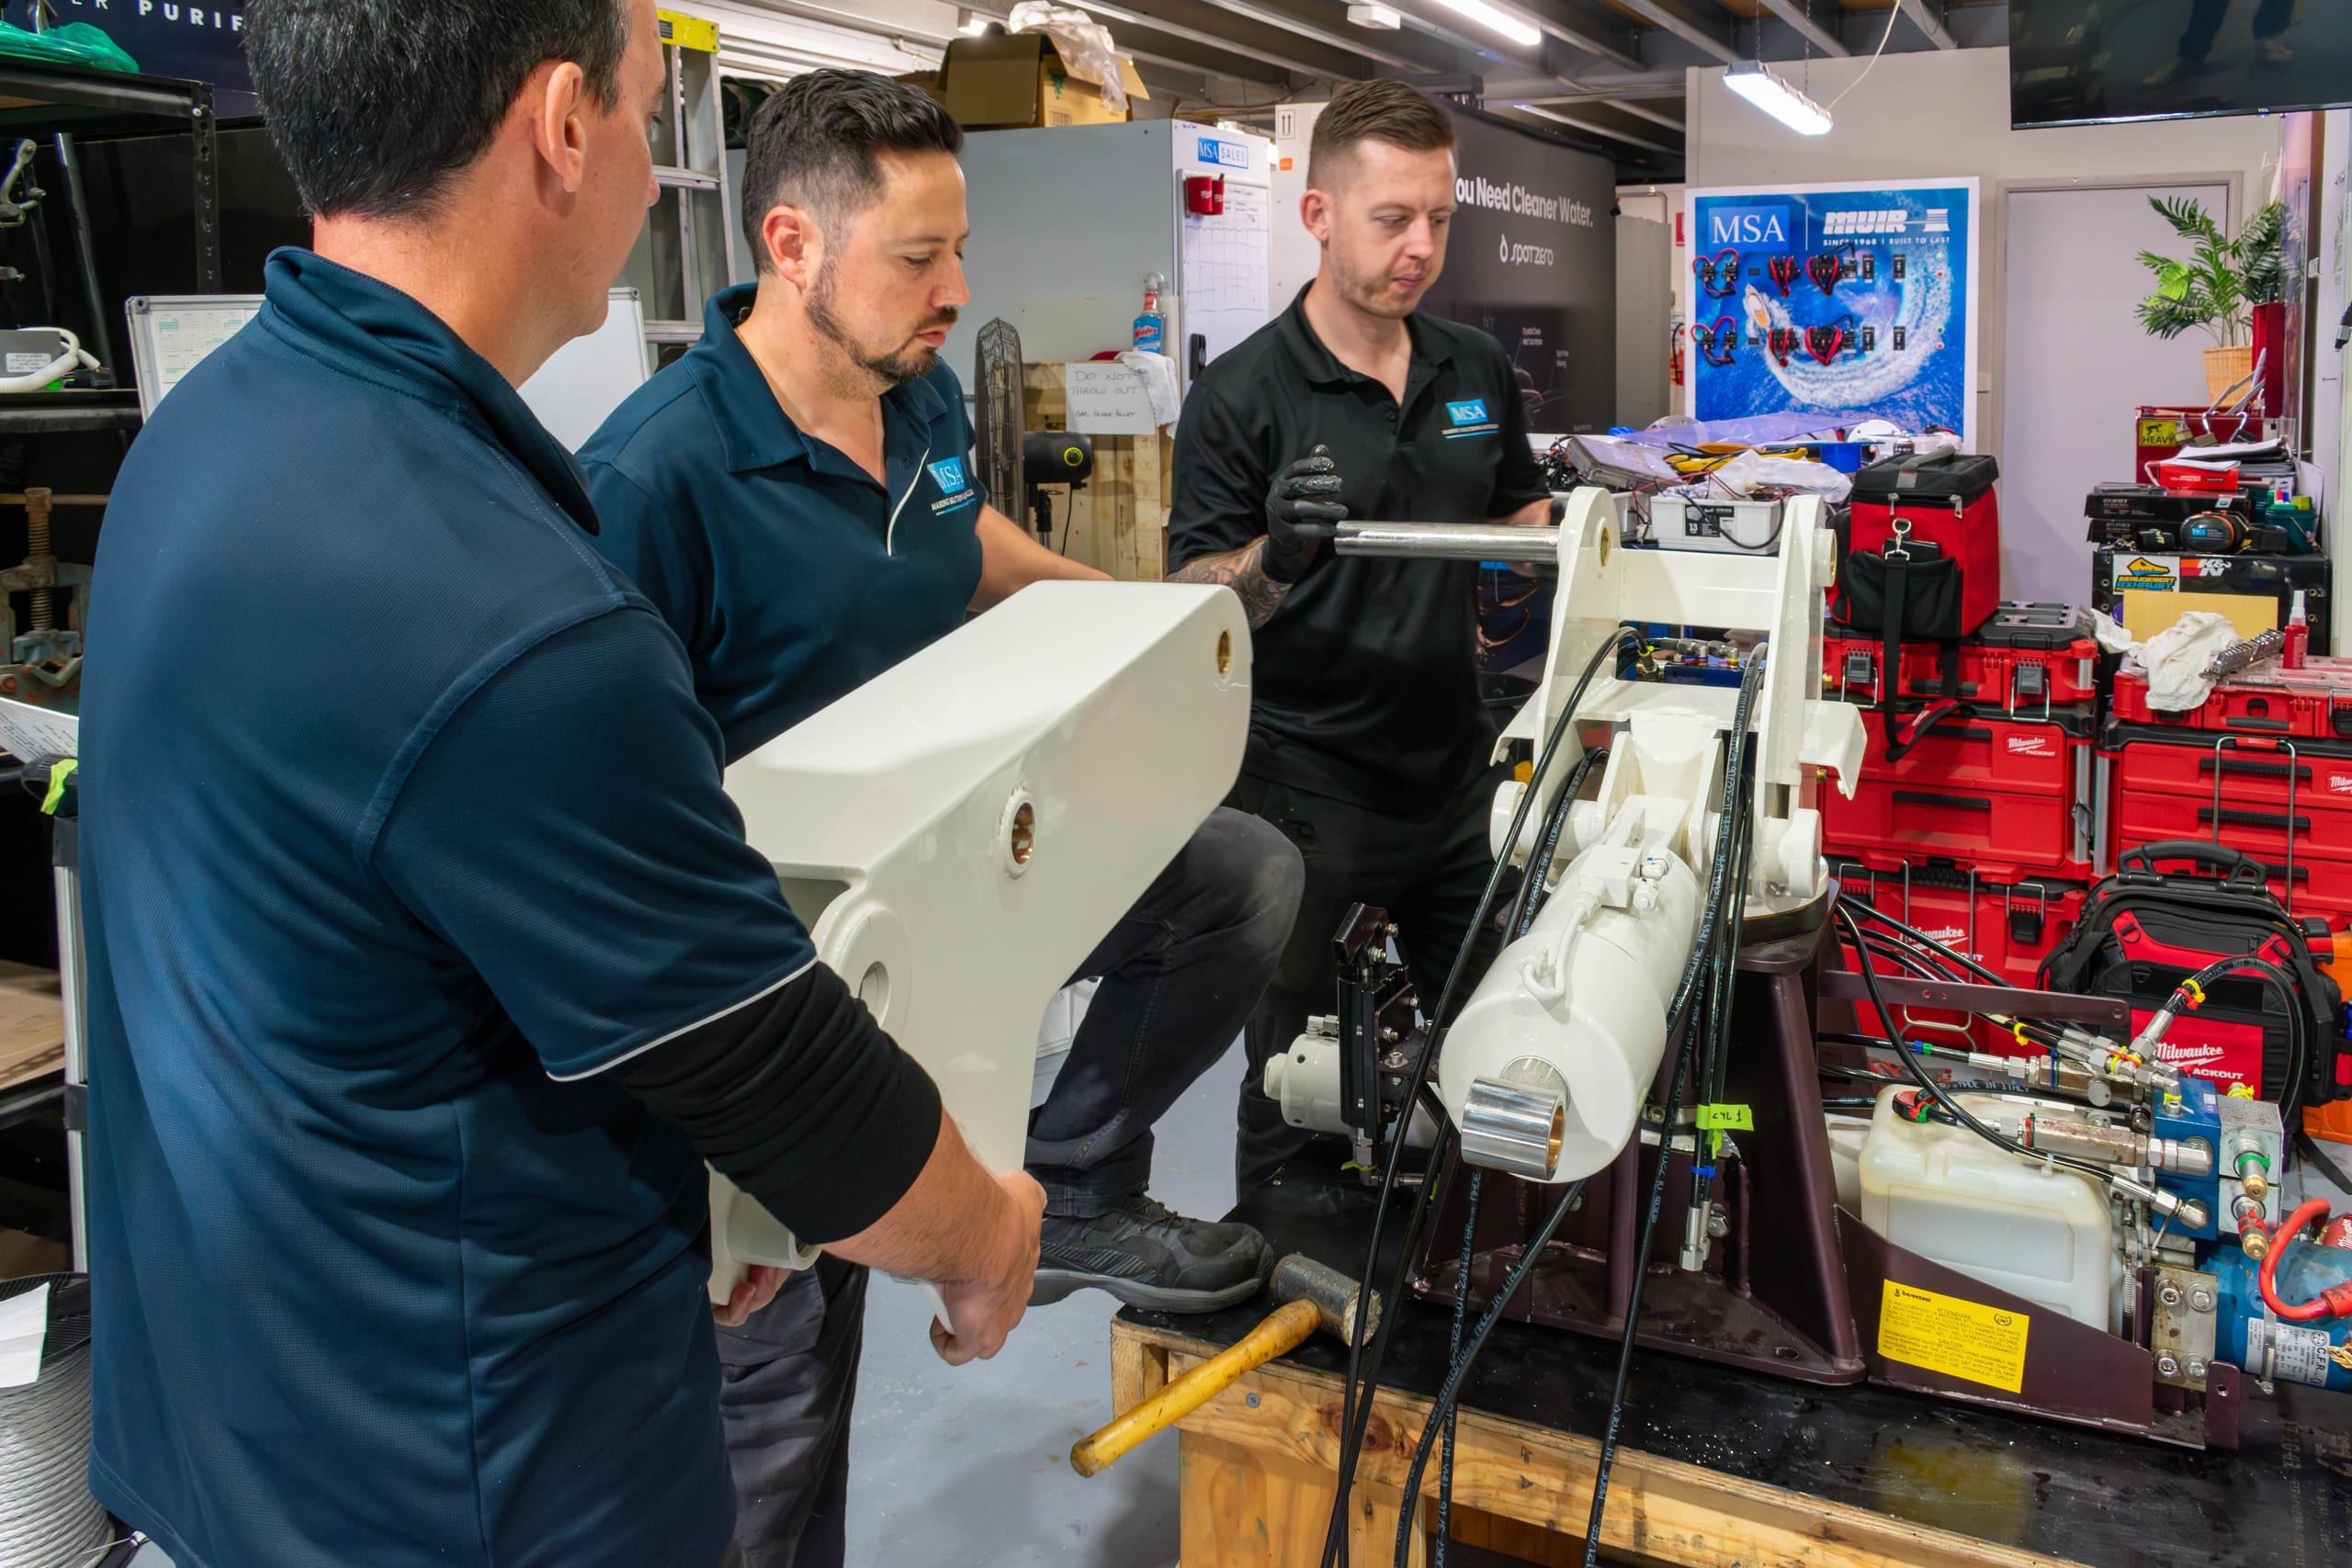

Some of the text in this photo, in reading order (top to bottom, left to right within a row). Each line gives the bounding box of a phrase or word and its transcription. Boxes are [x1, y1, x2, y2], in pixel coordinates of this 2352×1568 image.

[139, 1, 243, 31] PURIF
[1200, 141, 1246, 163] MSA SALES
[1476, 176, 1510, 212] Need
[1512, 186, 1558, 220] Cleaner
[1559, 196, 1594, 228] Water.
[1713, 214, 1786, 244] MSA
[1823, 210, 1908, 235] MUIR
[1823, 238, 1850, 247] SINCE
[1853, 238, 1877, 246] 1968
[1889, 237, 1912, 245] BUILT
[1929, 236, 1951, 244] LAST
[1075, 370, 1140, 382] DO NOT
[1069, 386, 1139, 396] THROW OUT
[1452, 404, 1487, 422] MSA
[2143, 435, 2175, 445] HEAVY
[933, 463, 964, 490] MSA
[2007, 738, 2045, 749] Milwaukee
[1683, 947, 1702, 987] MARINE
[1697, 921, 1710, 942] MAX
[1690, 1004, 1700, 1026] MAX
[2153, 1043, 2224, 1059] Milwaukee
[2193, 1067, 2244, 1079] ACKOUT
[1713, 1110, 1742, 1122] CYL 1
[1937, 1307, 1971, 1319] ATTENZIONE
[1441, 1463, 1449, 1487] MAX
[1469, 1172, 1477, 1201] MADE
[1938, 1338, 1962, 1348] CAUTION
